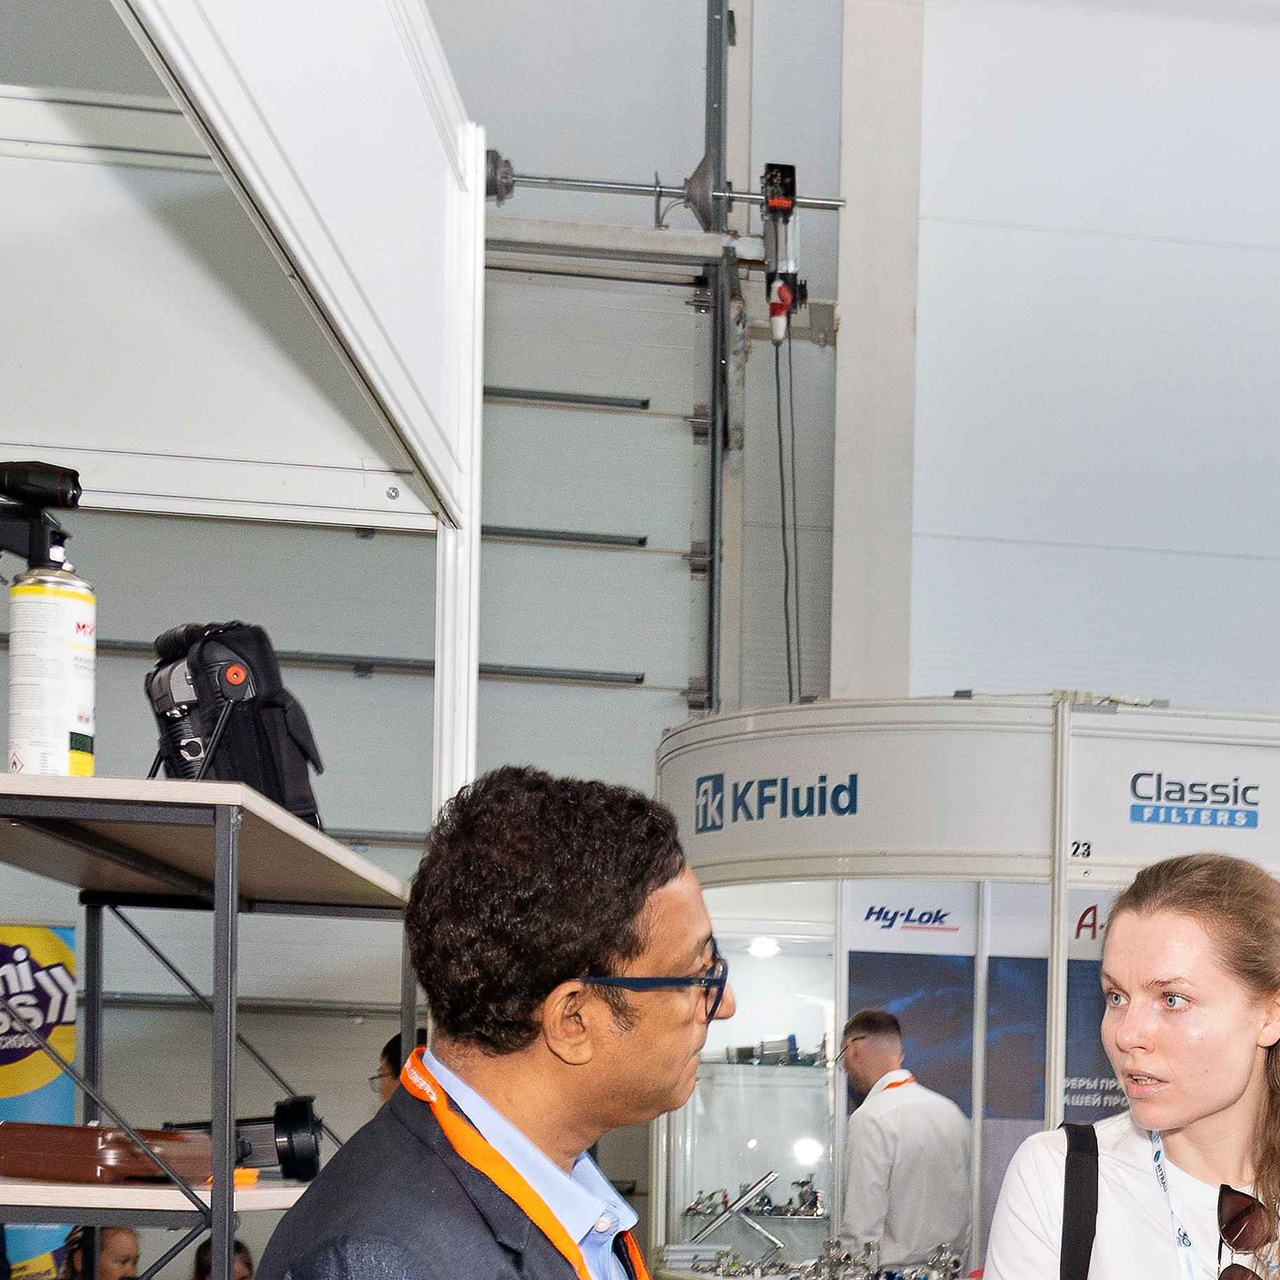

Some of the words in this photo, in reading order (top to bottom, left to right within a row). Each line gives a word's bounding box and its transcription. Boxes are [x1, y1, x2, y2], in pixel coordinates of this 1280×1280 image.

[731, 774, 859, 823] KFluid
[1130, 772, 1259, 805] Classic
[1143, 806, 1248, 827] FILTERS
[1070, 842, 1091, 858] 23
[863, 905, 951, 930] Hy-Lok
